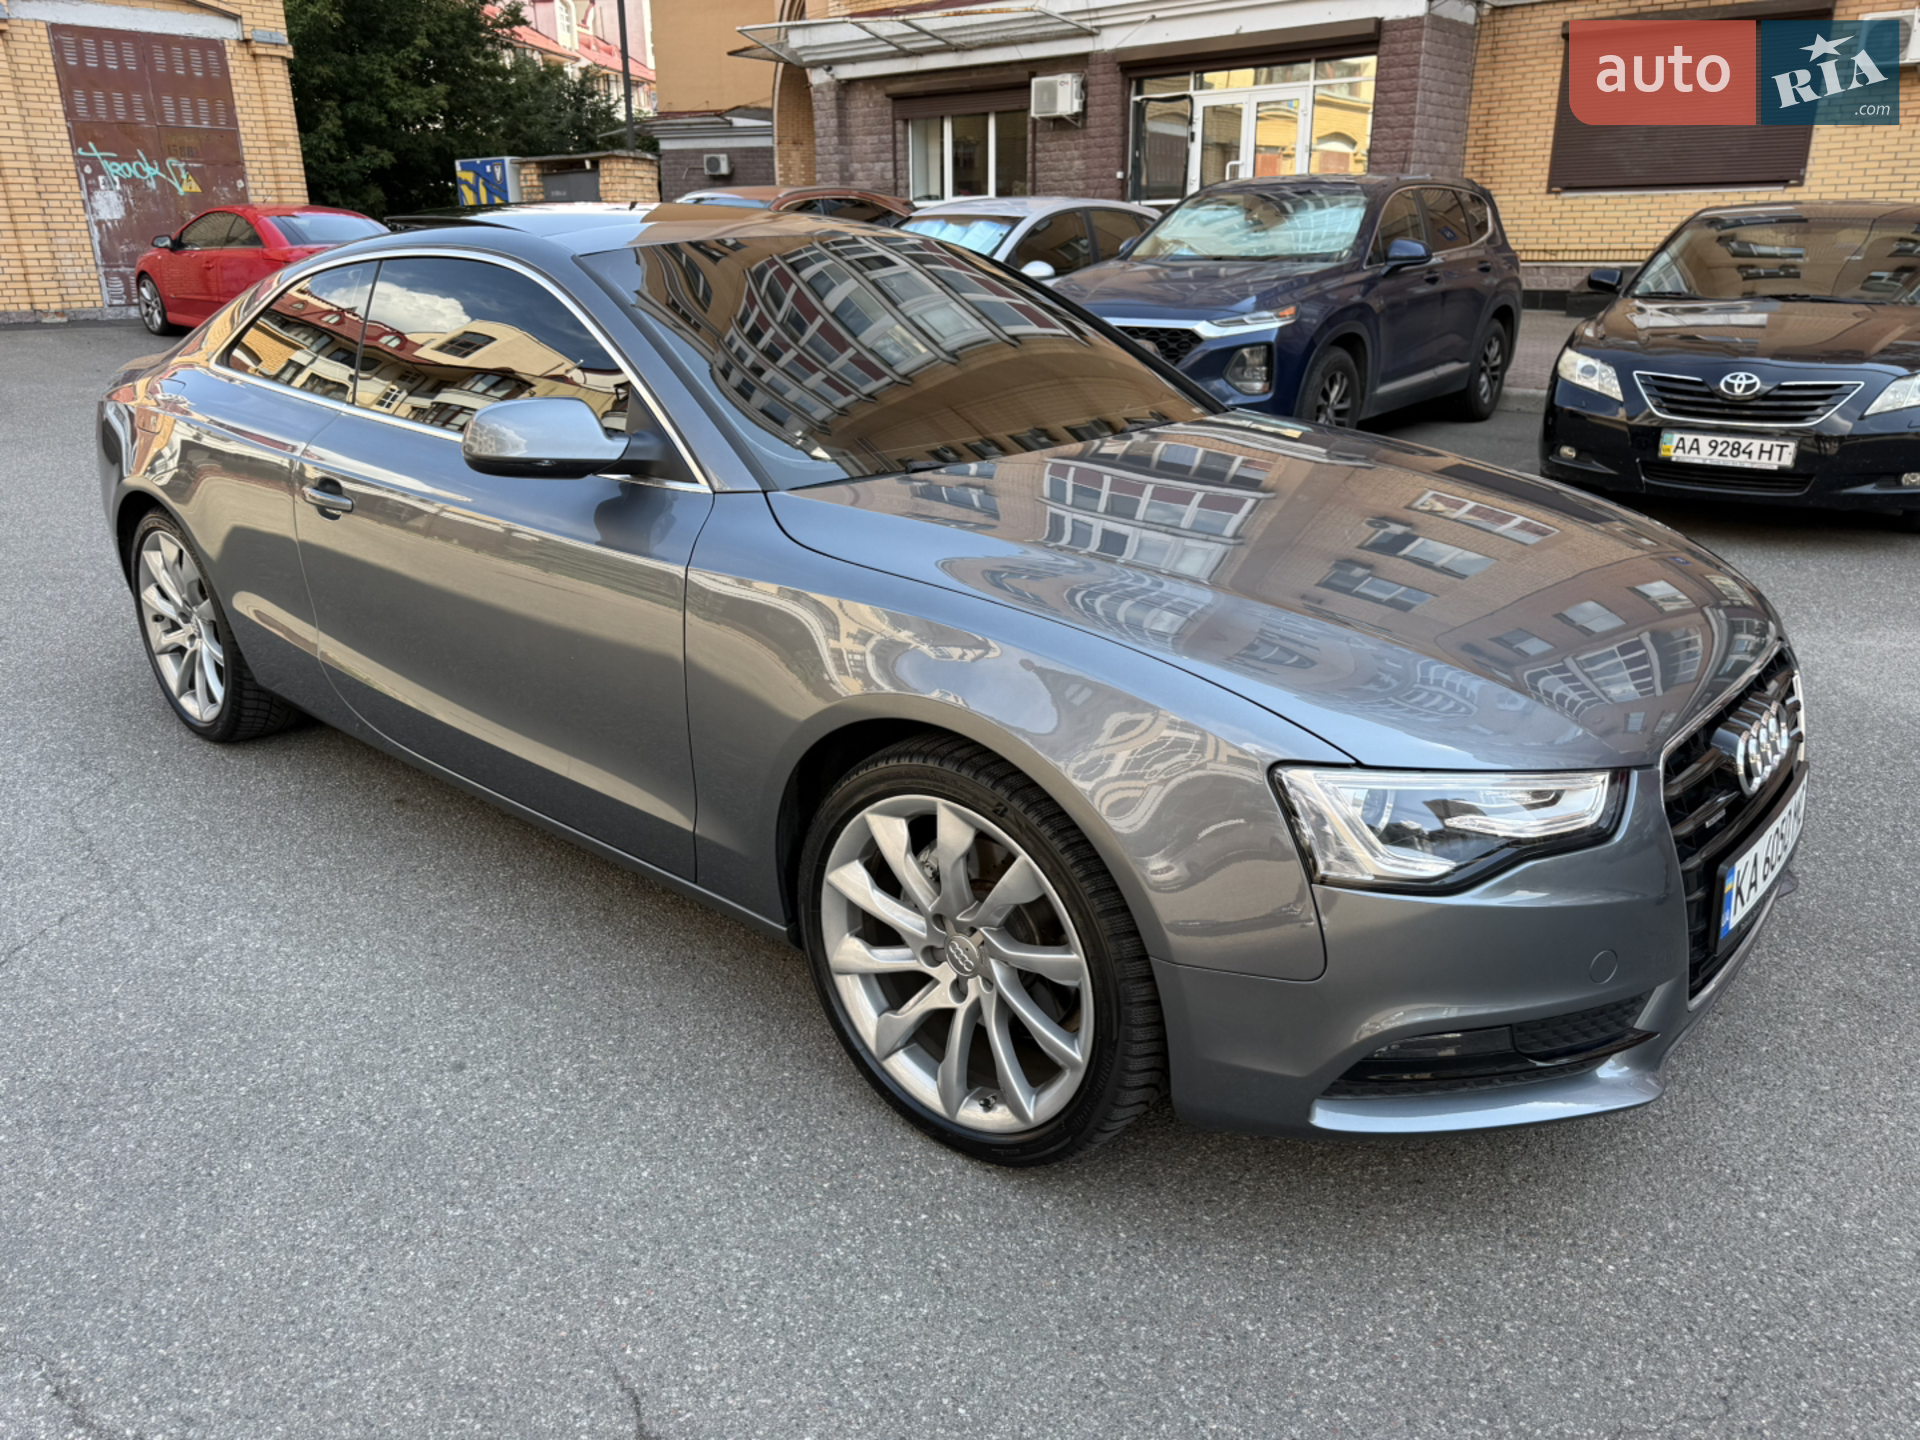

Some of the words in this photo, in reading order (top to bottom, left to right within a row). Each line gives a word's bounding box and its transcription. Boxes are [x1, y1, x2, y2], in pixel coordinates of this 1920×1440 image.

[1673, 437, 1701, 455] AA
[1707, 439, 1753, 460] 9284
[1758, 443, 1790, 462] HT
[1733, 851, 1758, 916] KA
